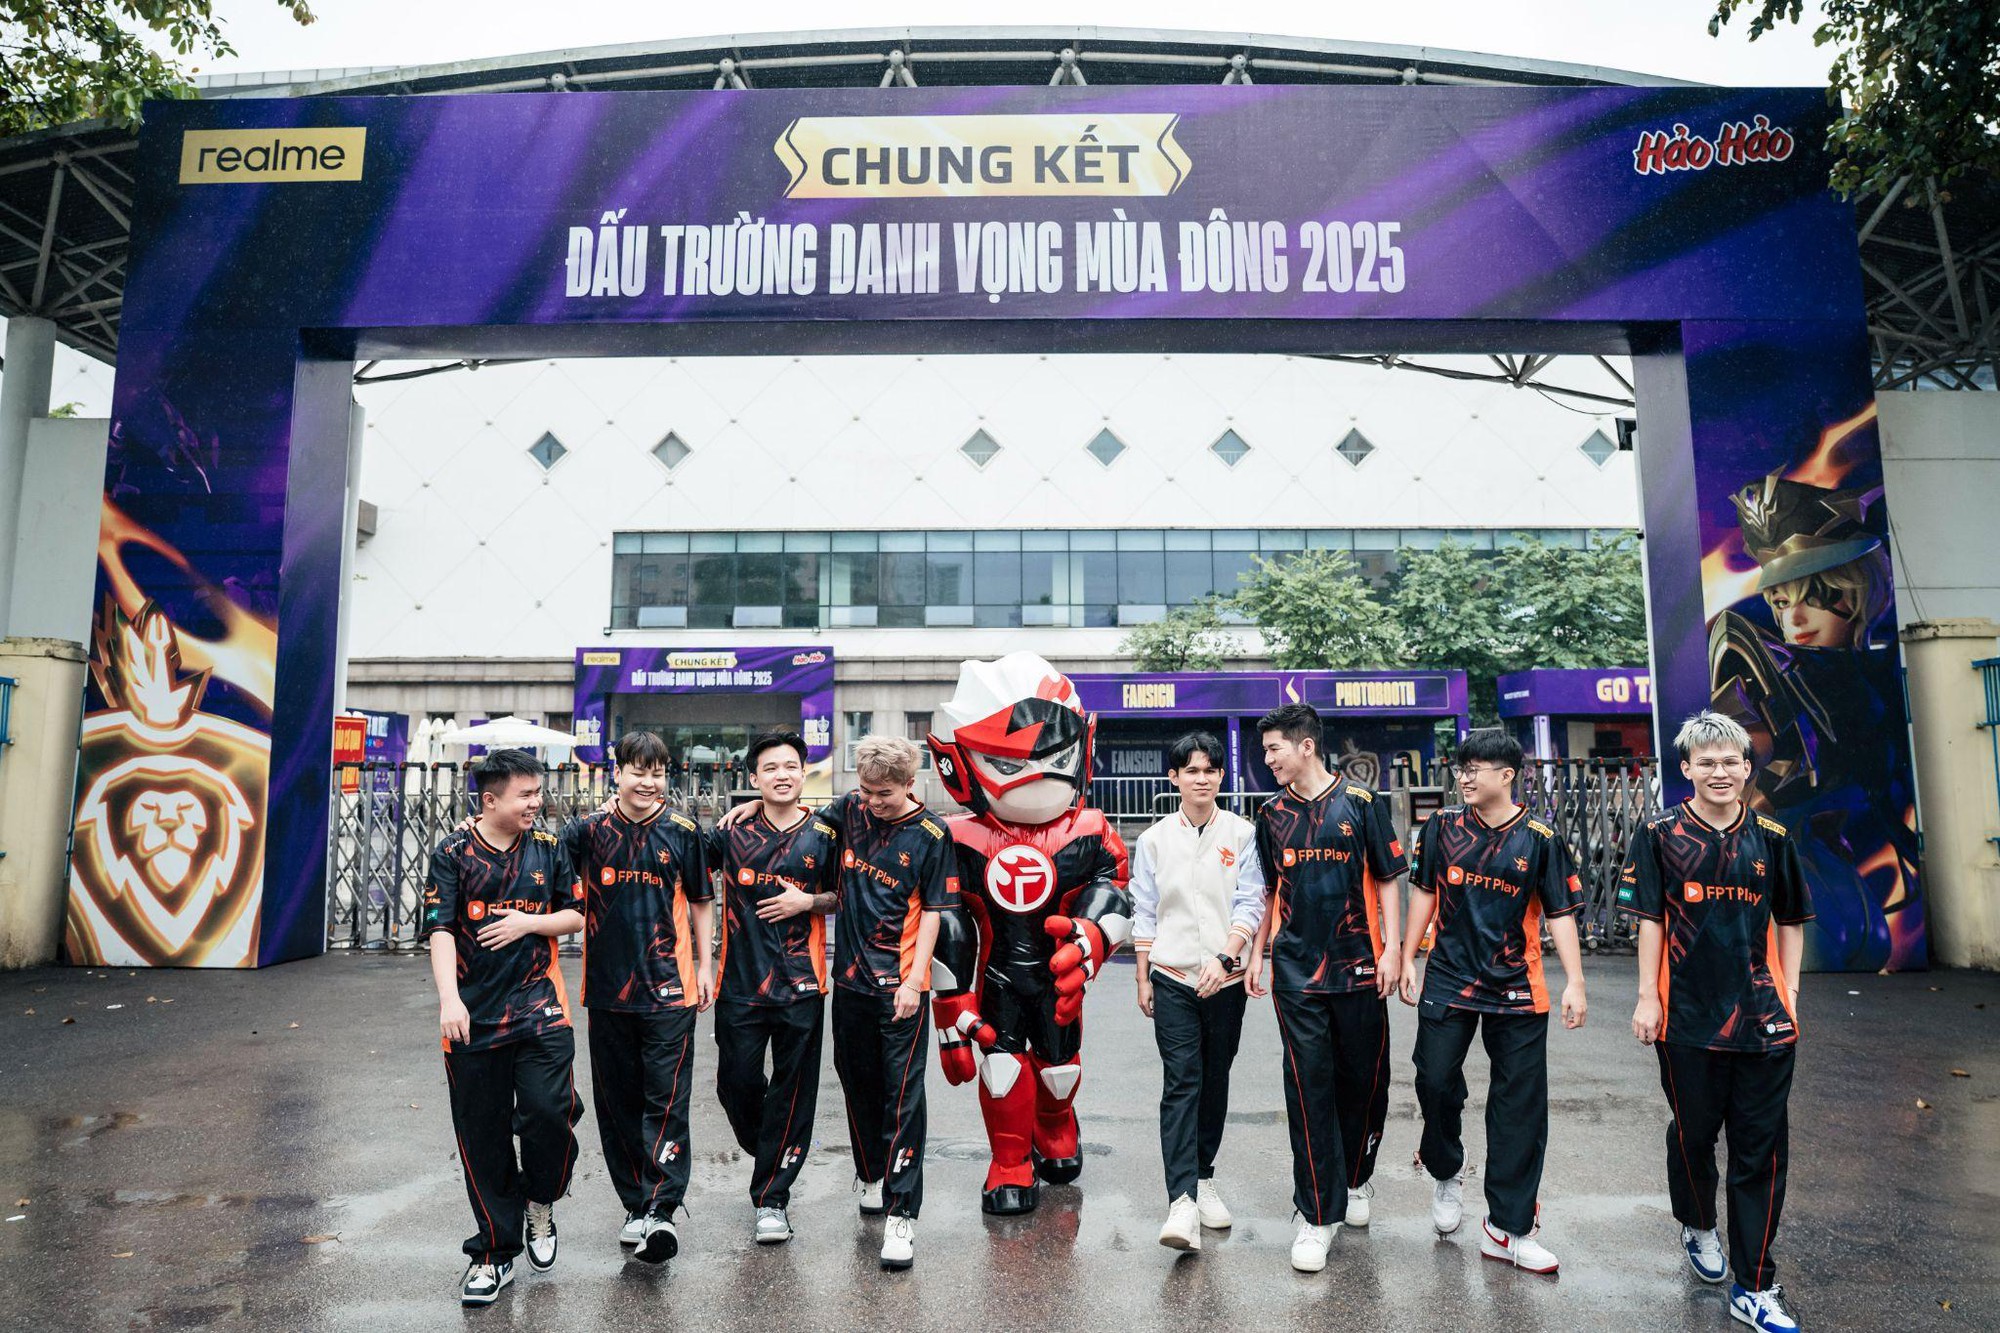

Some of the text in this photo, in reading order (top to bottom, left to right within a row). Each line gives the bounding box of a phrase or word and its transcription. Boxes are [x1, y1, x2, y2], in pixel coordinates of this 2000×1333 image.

[198, 139, 346, 172] realme
[822, 124, 1140, 186] CHUNG KẾT
[1634, 114, 1794, 175] Hảo Hảo
[565, 208, 1406, 304] ĐẤU TRƯỜNG DANH VỌNG MÙA ĐÔNG 2025
[674, 654, 729, 667] CHUNG KẾT
[1122, 684, 1176, 708] FANSIGN
[1335, 681, 1416, 706] PHOTOBOOTH
[1596, 676, 1653, 703] GO T
[1111, 750, 1163, 774] FANSIGN
[1297, 849, 1351, 864] FPT Play
[617, 870, 664, 889] FPT Play
[854, 858, 900, 889] FPT Play
[1465, 873, 1521, 898] FPT Play
[1706, 886, 1735, 900] FPT
